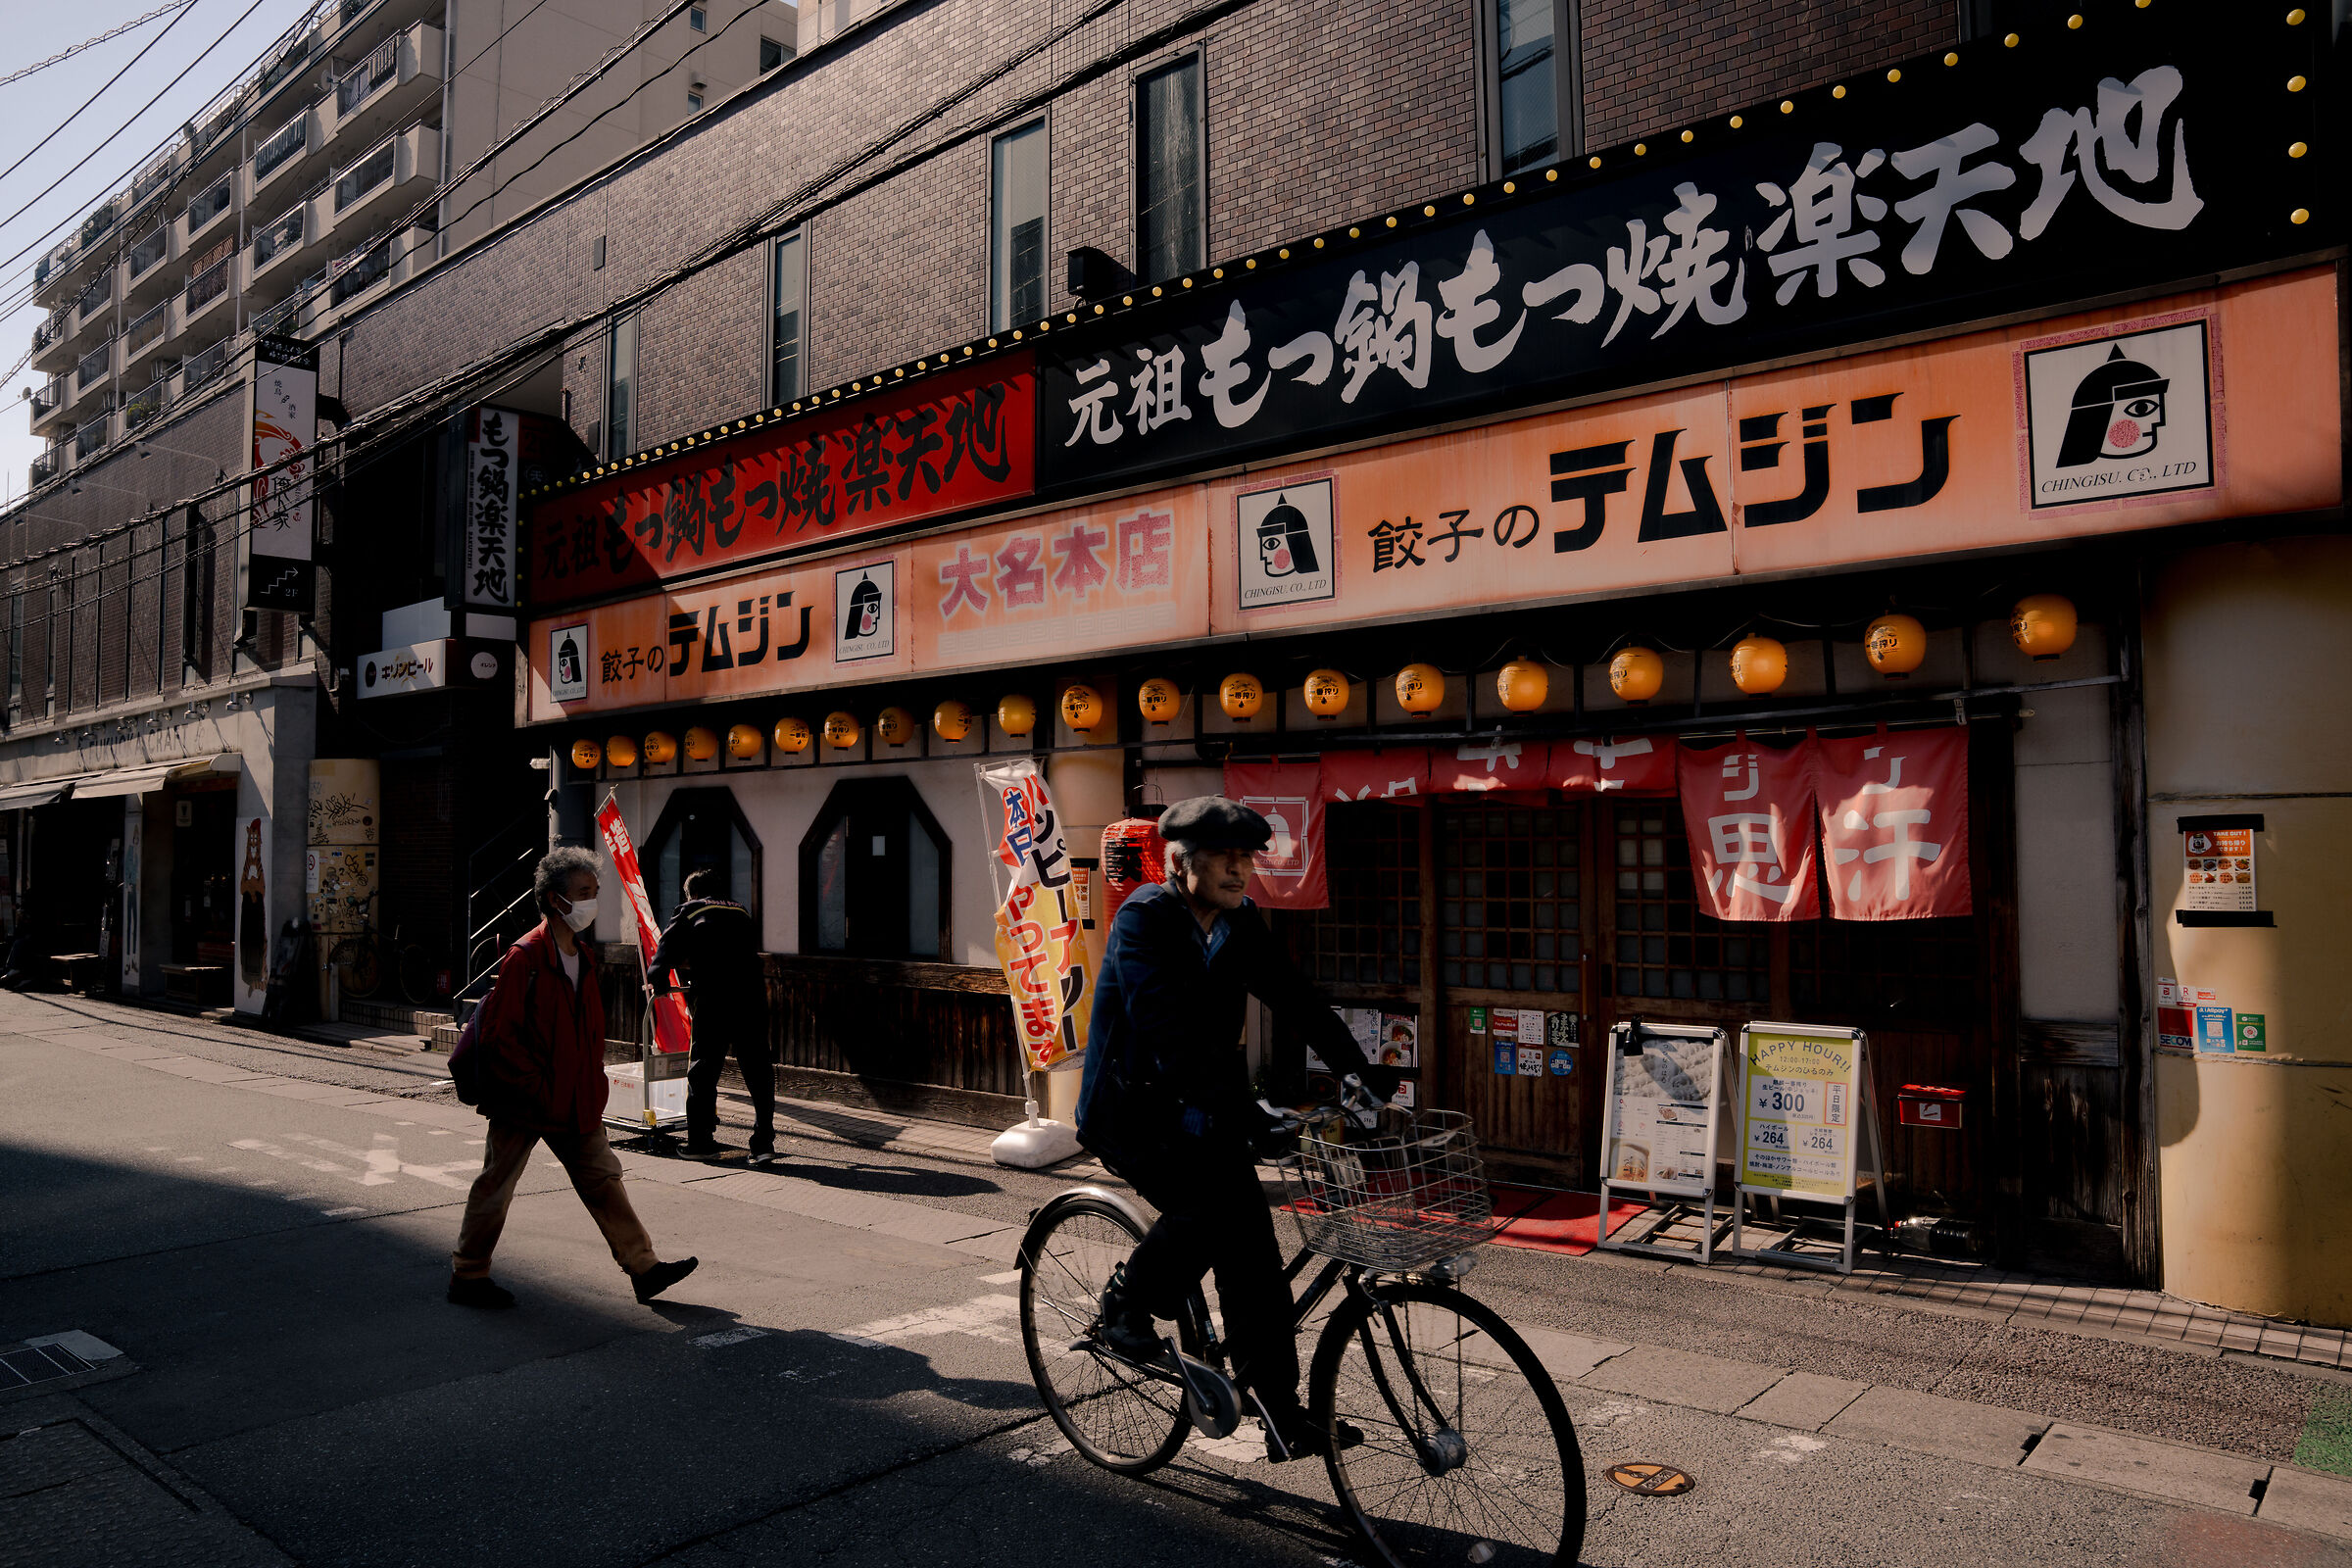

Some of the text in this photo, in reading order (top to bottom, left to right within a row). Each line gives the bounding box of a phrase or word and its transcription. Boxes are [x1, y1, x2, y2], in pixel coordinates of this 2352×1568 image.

[1063, 64, 2207, 451] 元祖もつ鍋もつ焼楽天地
[540, 383, 1016, 580] 元祖もつ鍋もつ焼楽天地
[1368, 392, 1962, 575] 餃子のテムジン
[2162, 461, 2196, 477] LTD
[475, 412, 510, 604] もつ鍋楽天地
[939, 512, 1173, 618] 大名本店
[1308, 579, 1327, 590] LTD
[600, 590, 815, 684] 餃子のテムジン
[382, 658, 433, 679] キリンビール
[1229, 690, 1255, 701] 一番搾り
[1749, 1040, 1852, 1073] HAPPY HOUR!!
[2160, 1034, 2192, 1047] SECOM
[1832, 1084, 1840, 1123] 平日限定
[1762, 1131, 1785, 1145] 264
[1811, 1136, 1834, 1150] 264
